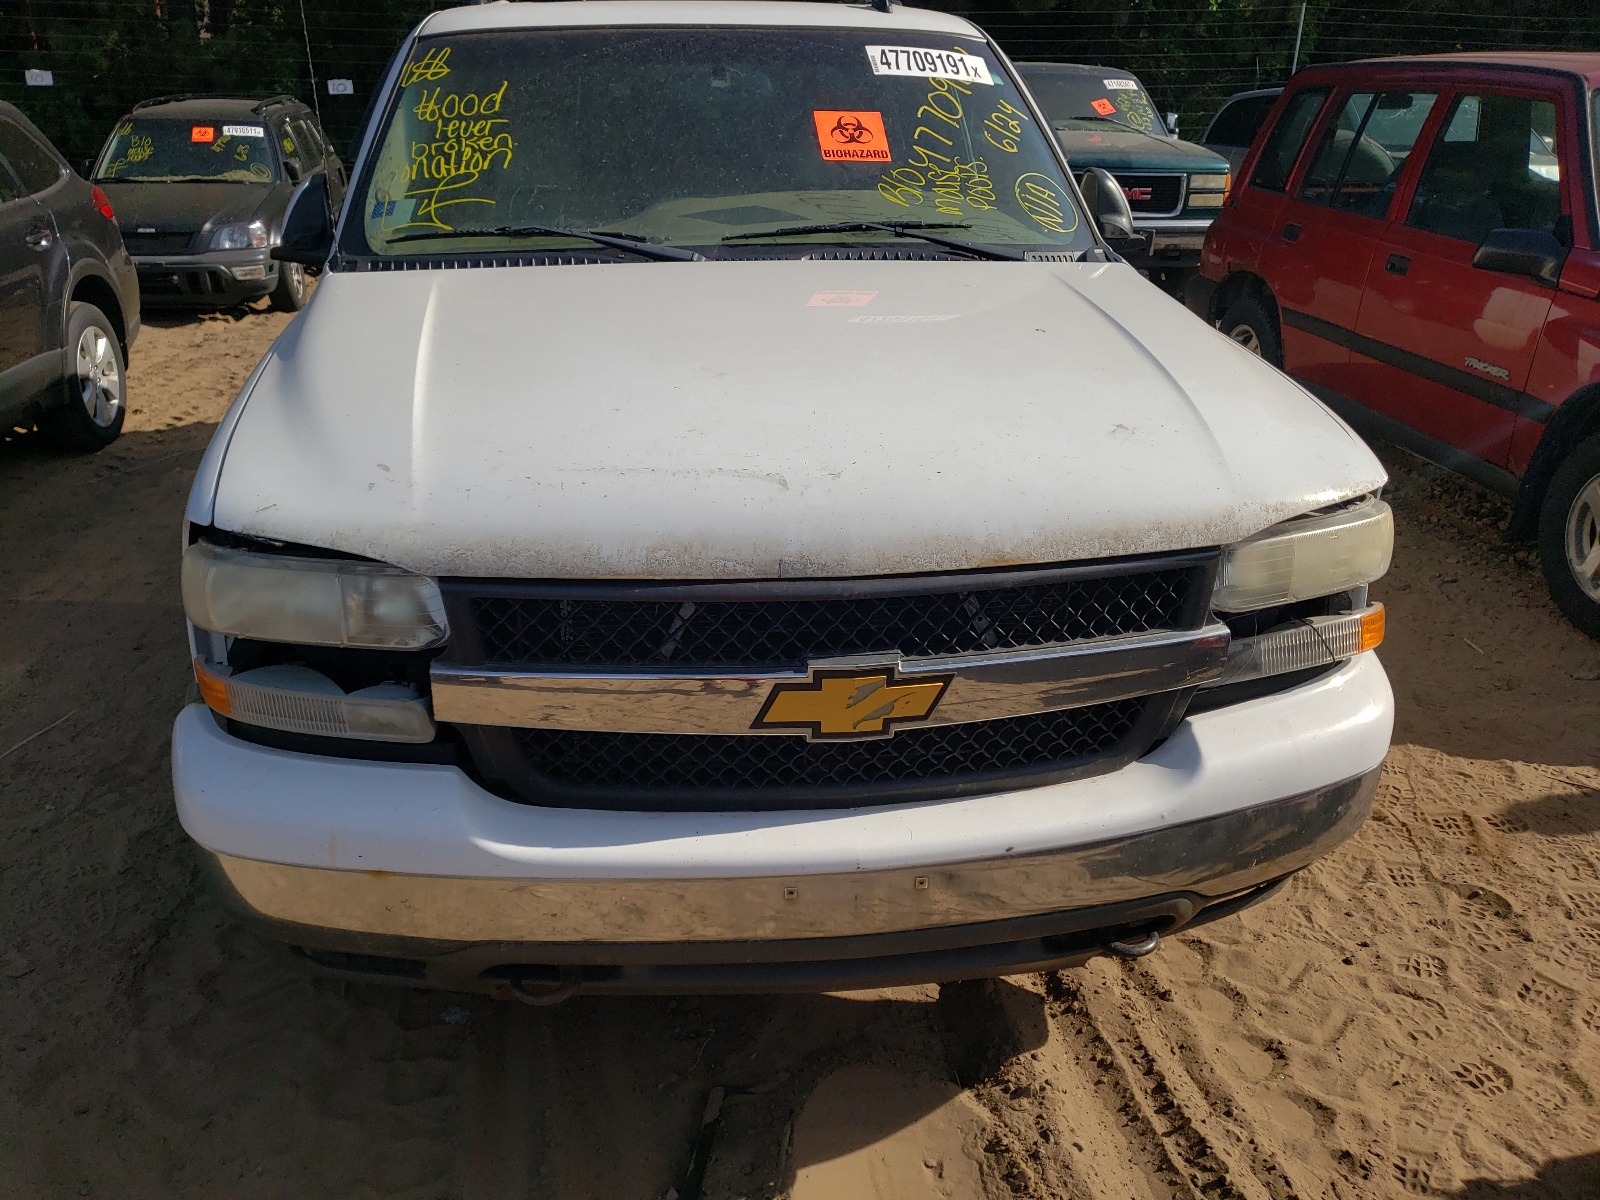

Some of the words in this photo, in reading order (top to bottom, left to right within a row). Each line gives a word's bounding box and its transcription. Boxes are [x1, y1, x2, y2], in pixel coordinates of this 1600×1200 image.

[880, 49, 971, 77] 47709191
[411, 133, 513, 159] broken
[823, 149, 889, 160] BIOHAZARD
[1122, 187, 1152, 201] MC
[1464, 356, 1511, 381] TRACKER
